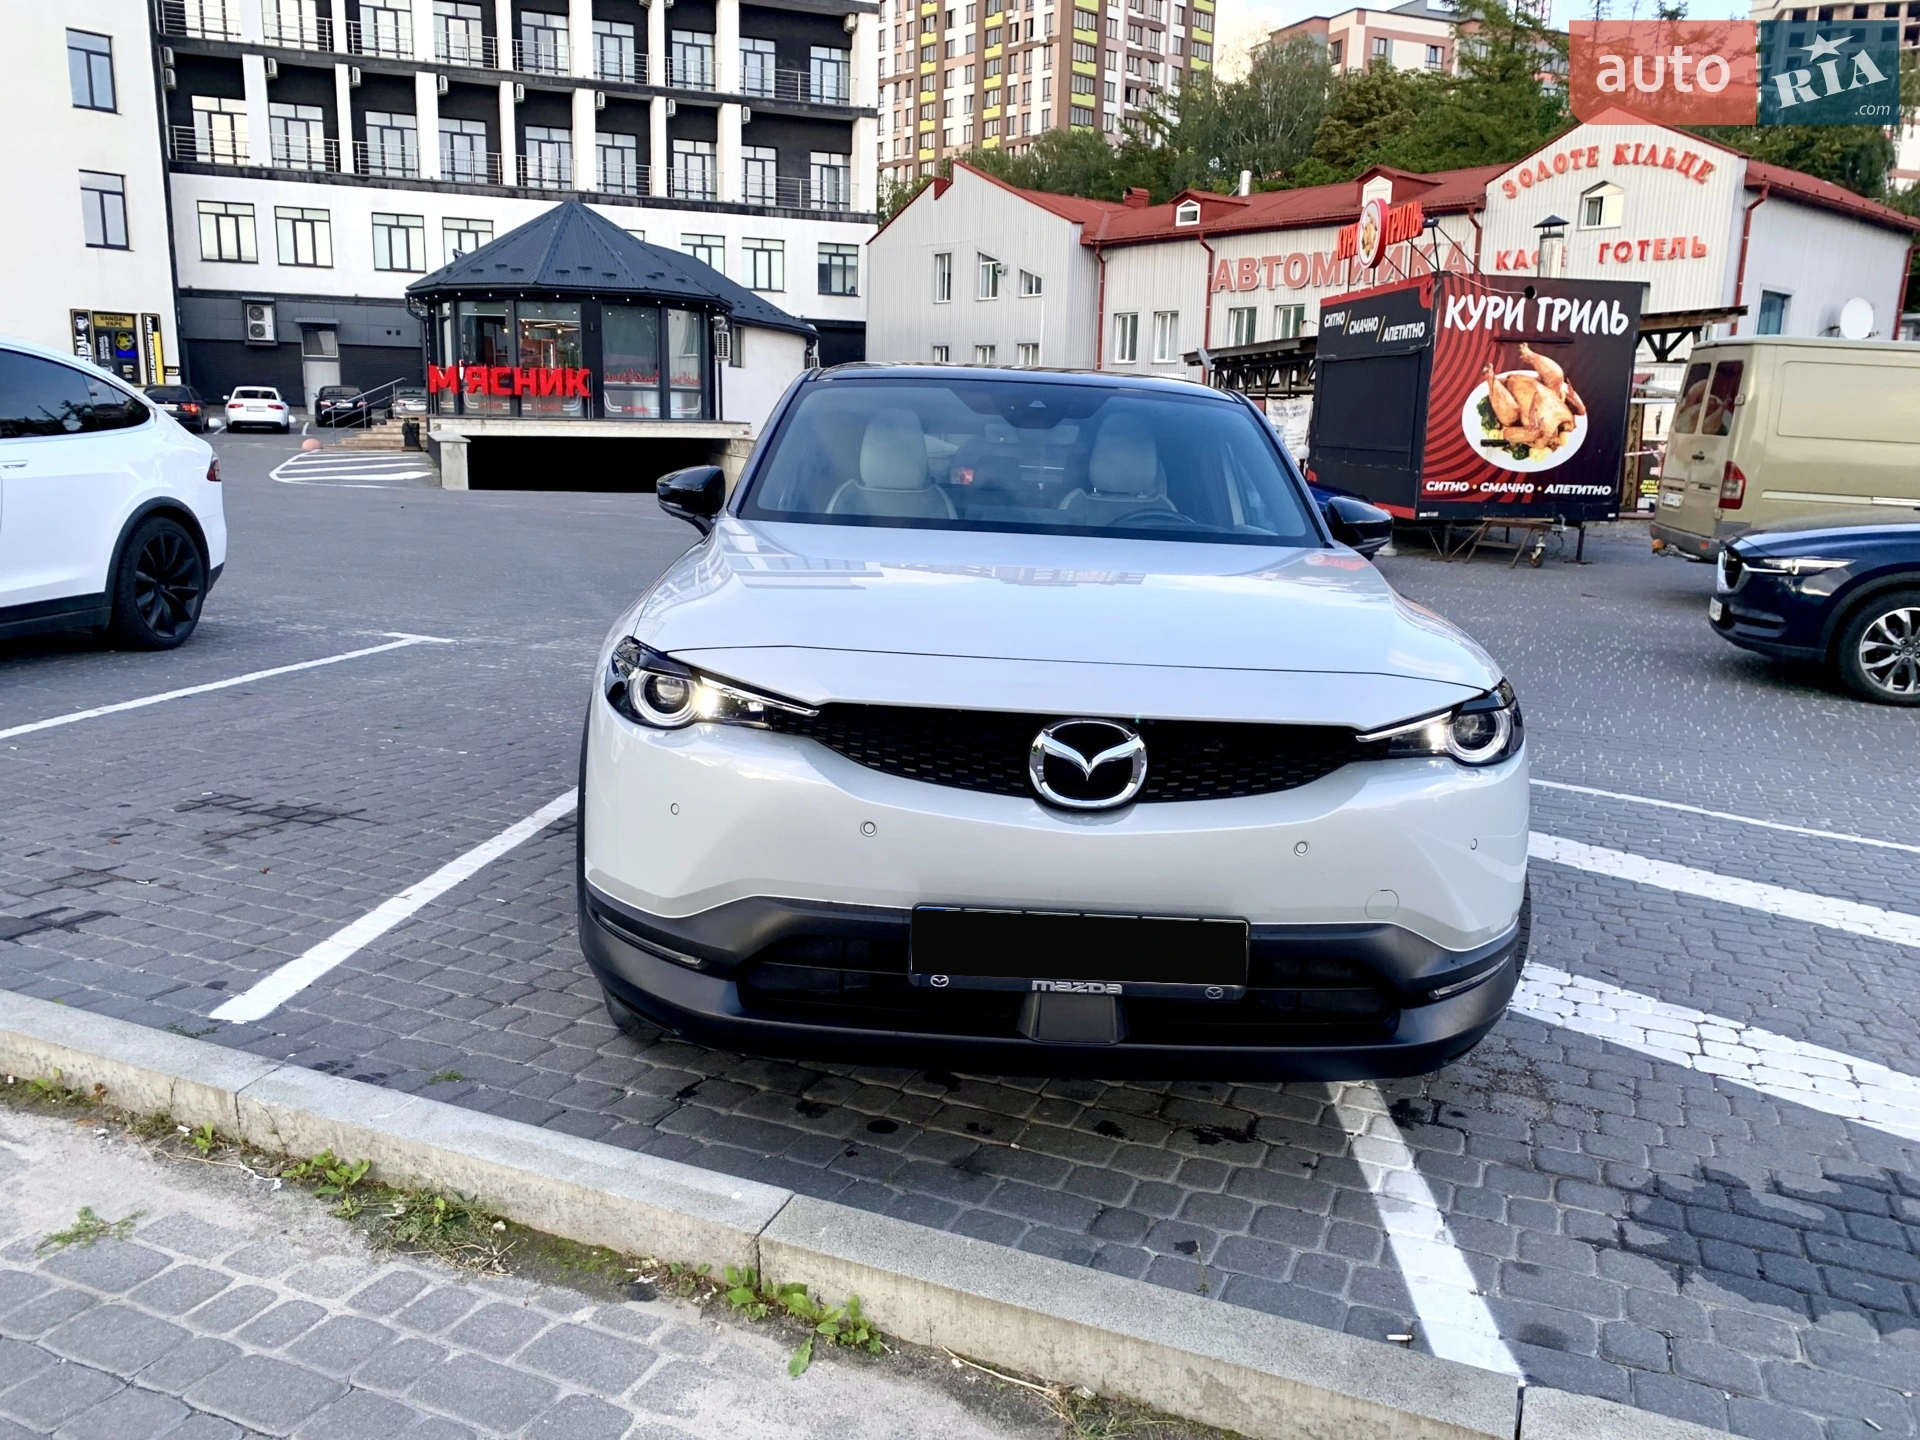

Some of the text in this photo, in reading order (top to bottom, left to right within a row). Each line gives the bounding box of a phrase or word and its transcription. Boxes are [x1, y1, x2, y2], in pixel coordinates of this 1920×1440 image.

[1502, 143, 1715, 199] ЗОЛОТЕ КІЛЬЦЕ
[1385, 201, 1424, 245] ГРИЛЬ
[1598, 236, 1708, 264] ГОТЕЛЬ
[1324, 311, 1425, 342] СИТНО СМАЧНО АПЕТИТНО
[1444, 294, 1629, 335] КУРИ ГРИЛЬ
[1426, 481, 1612, 495] СИТНО СМАЧНО АПЕТИТНО
